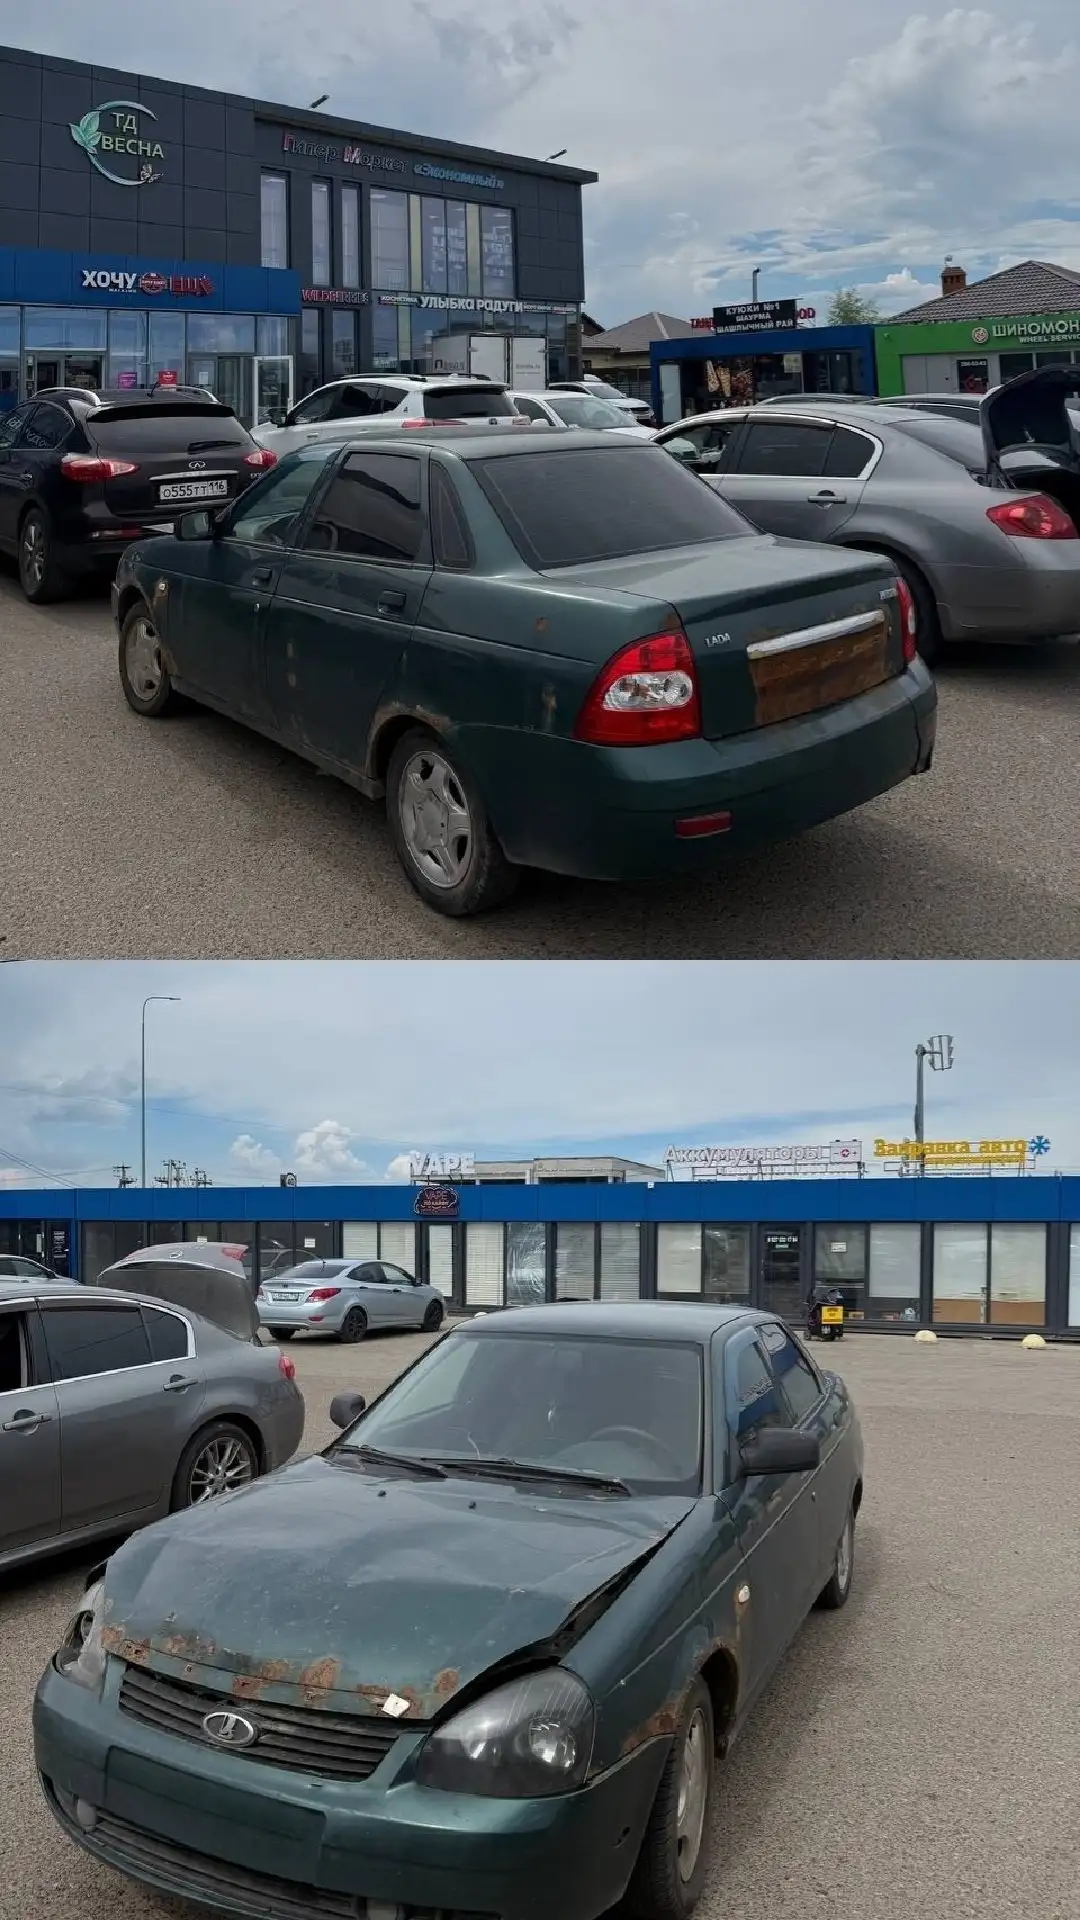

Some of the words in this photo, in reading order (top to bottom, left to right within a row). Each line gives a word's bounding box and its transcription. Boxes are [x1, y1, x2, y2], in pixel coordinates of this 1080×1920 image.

[112, 112, 138, 134] ТД
[100, 135, 165, 159] ВЕСНА
[82, 270, 137, 289] ХОЧУ
[726, 303, 760, 316] КУЮКИ
[735, 312, 772, 322] ШАУРМА
[716, 320, 775, 333] ШАШЛЫЧНЫЙ
[775, 318, 793, 328] РАЙ
[1019, 335, 1048, 343] WHEEL
[208, 481, 225, 491] 116
[704, 632, 731, 648] LADA
[979, 1140, 1026, 1153] авто
[663, 1144, 823, 1167] Аккумуляторы
[409, 1151, 475, 1176] VAPE
